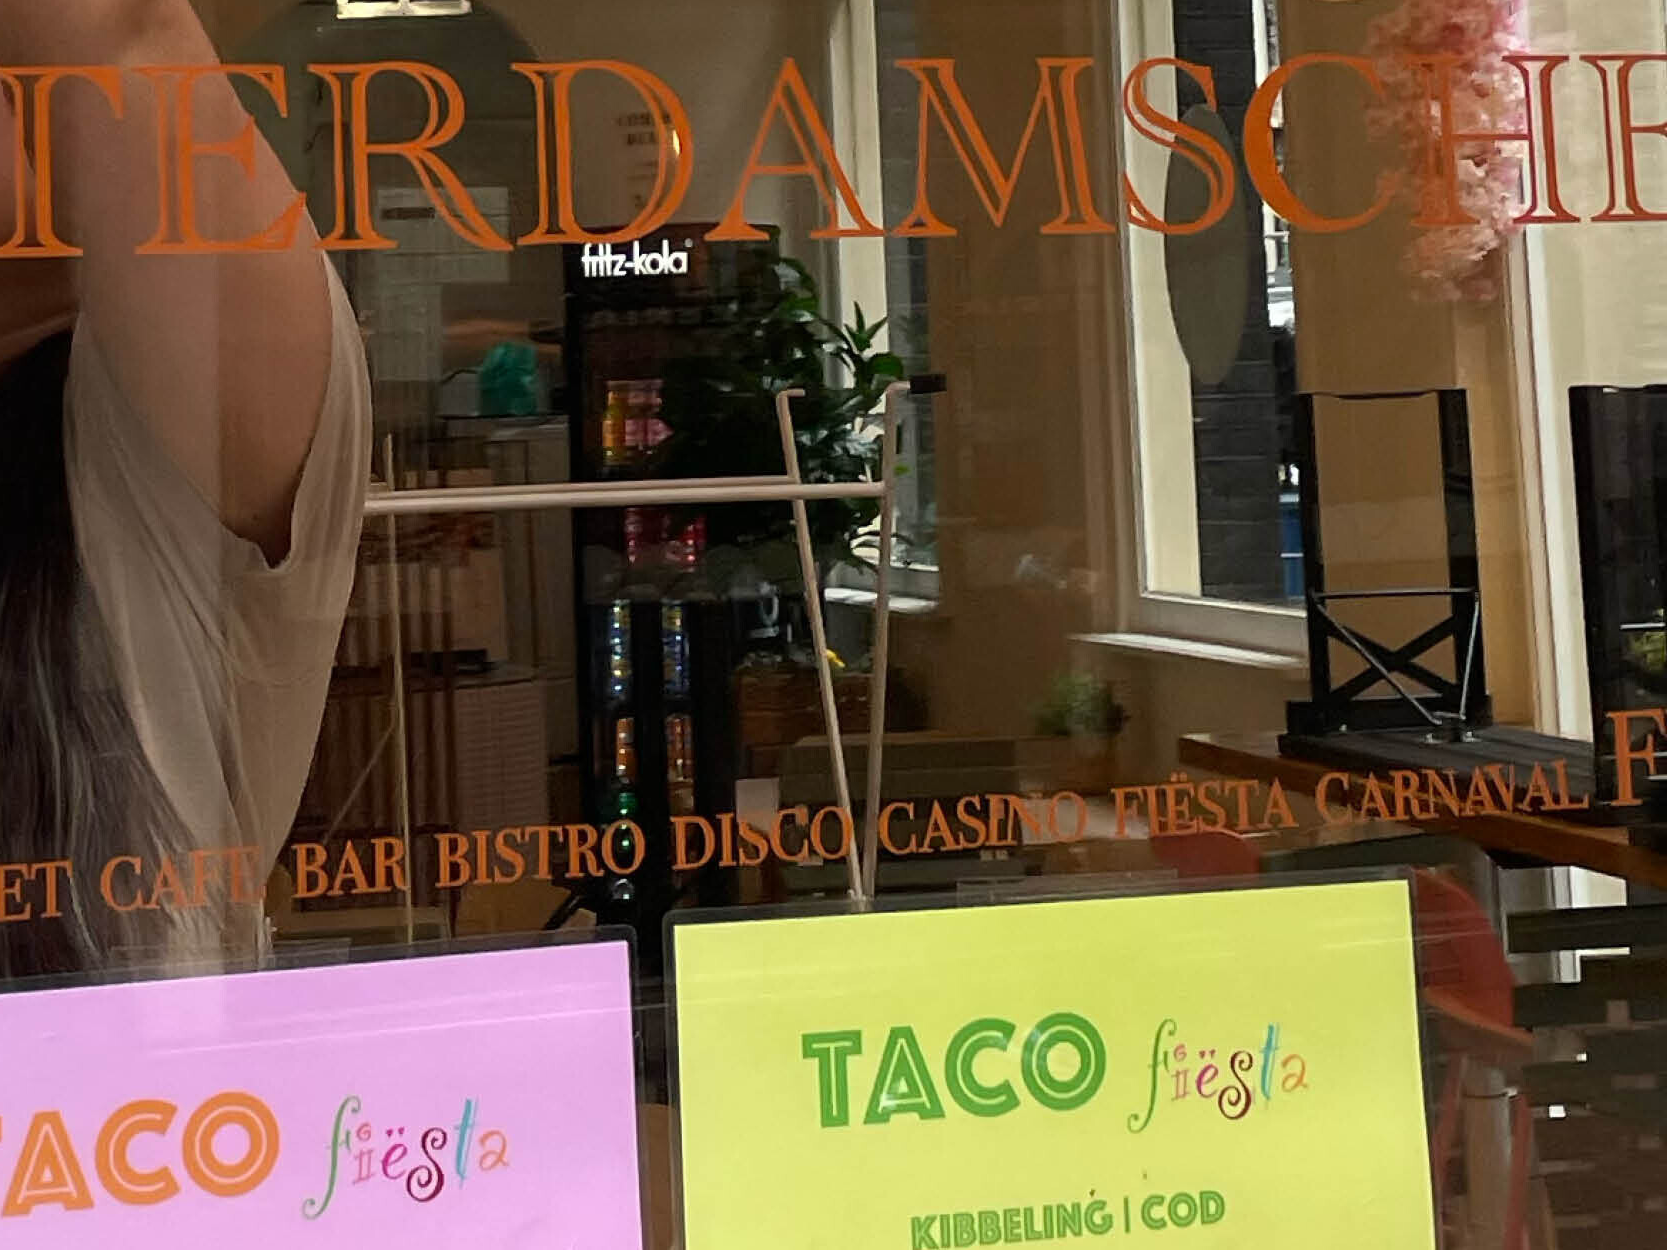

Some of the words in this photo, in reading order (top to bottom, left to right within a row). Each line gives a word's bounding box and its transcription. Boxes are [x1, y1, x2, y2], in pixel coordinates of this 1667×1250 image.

[581, 239, 688, 278] fritz-kola
[291, 836, 412, 900] BAR
[434, 819, 646, 889] BISTRO
[671, 805, 855, 872] DISCO
[878, 789, 1088, 855] CASINO
[1111, 771, 1300, 841] FIËSTA
[1314, 759, 1591, 827] CARNAVAL
[801, 1010, 1108, 1130] TACO
[911, 1198, 1114, 1250] KIBBELING
[1140, 1189, 1226, 1230] COD
